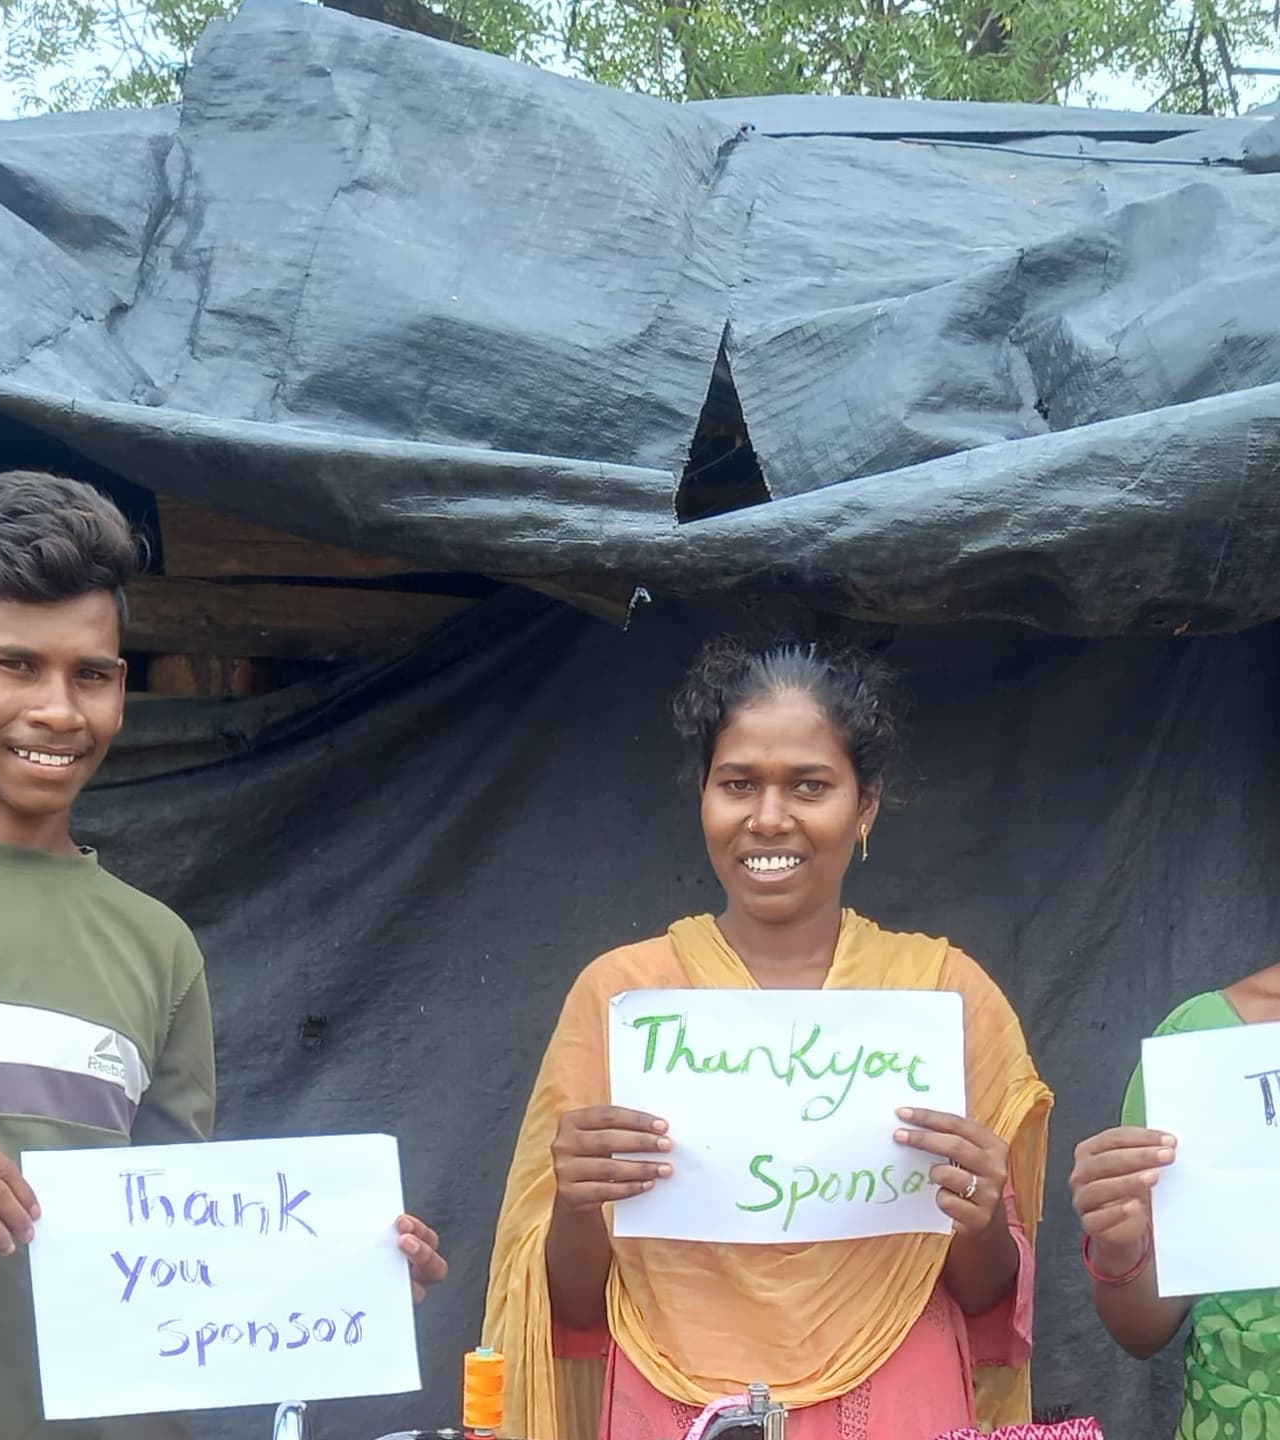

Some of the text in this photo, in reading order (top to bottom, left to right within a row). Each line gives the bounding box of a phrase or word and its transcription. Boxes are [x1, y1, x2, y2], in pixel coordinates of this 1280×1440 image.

[87, 1055, 126, 1080] Reebo
[118, 1169, 318, 1238] Thank
[734, 1154, 936, 1232] Sponso
[110, 1250, 217, 1304] you
